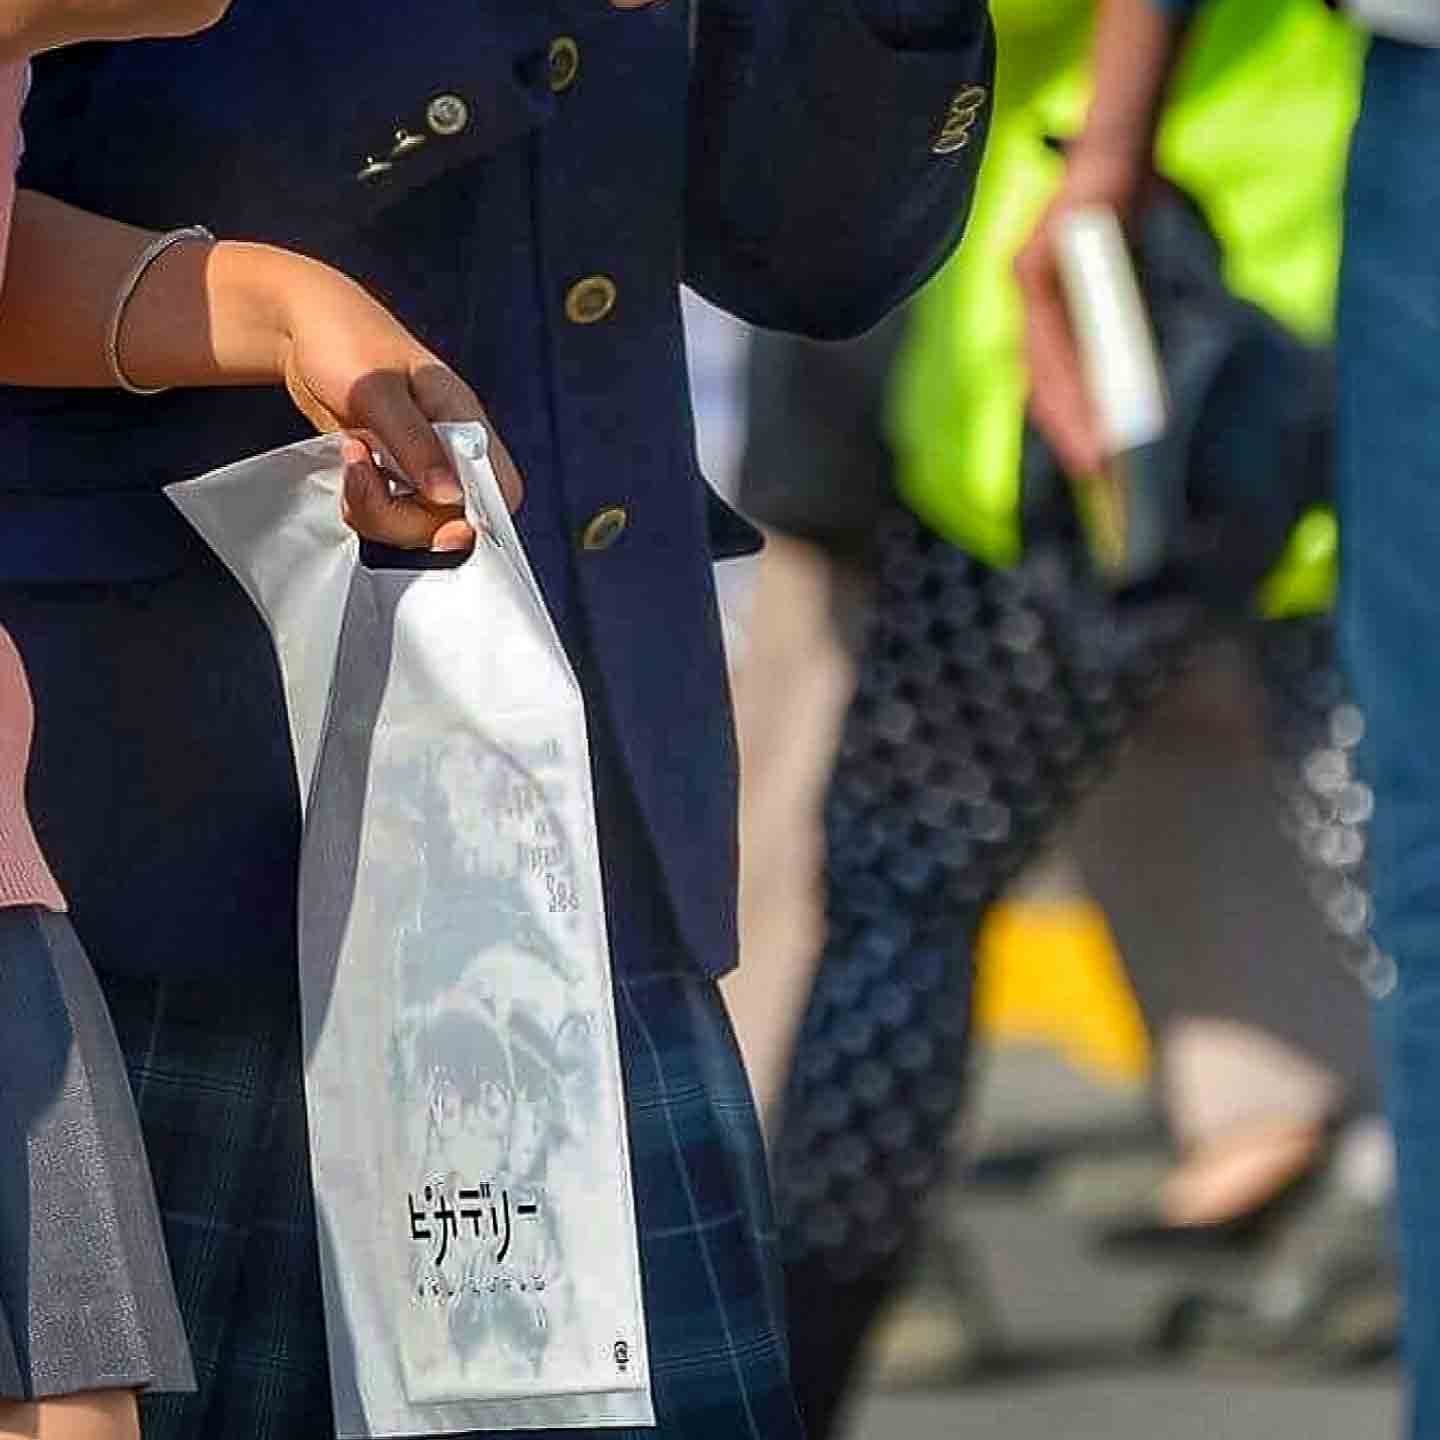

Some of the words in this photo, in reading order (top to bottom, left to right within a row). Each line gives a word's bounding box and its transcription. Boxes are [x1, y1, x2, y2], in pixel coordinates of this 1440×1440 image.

[408, 1181, 537, 1266] ピカデリー
